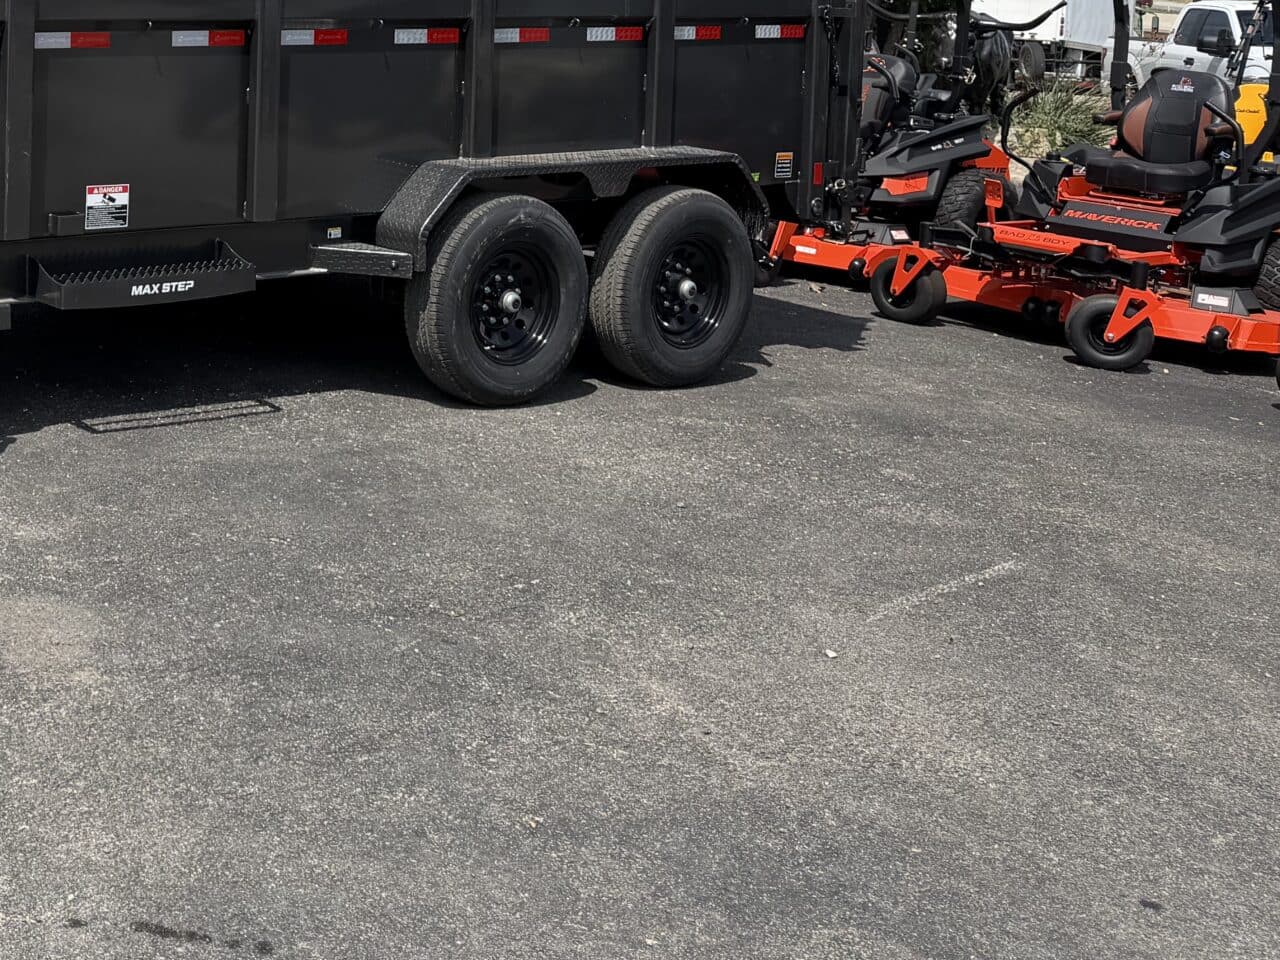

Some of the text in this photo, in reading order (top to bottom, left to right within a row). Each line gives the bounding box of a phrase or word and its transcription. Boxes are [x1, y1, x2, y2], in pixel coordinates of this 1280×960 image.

[98, 186, 123, 194] DANGER
[1064, 209, 1162, 231] MAVERICK
[999, 229, 1070, 246] BAD BOY
[131, 280, 195, 296] MAX STEP
